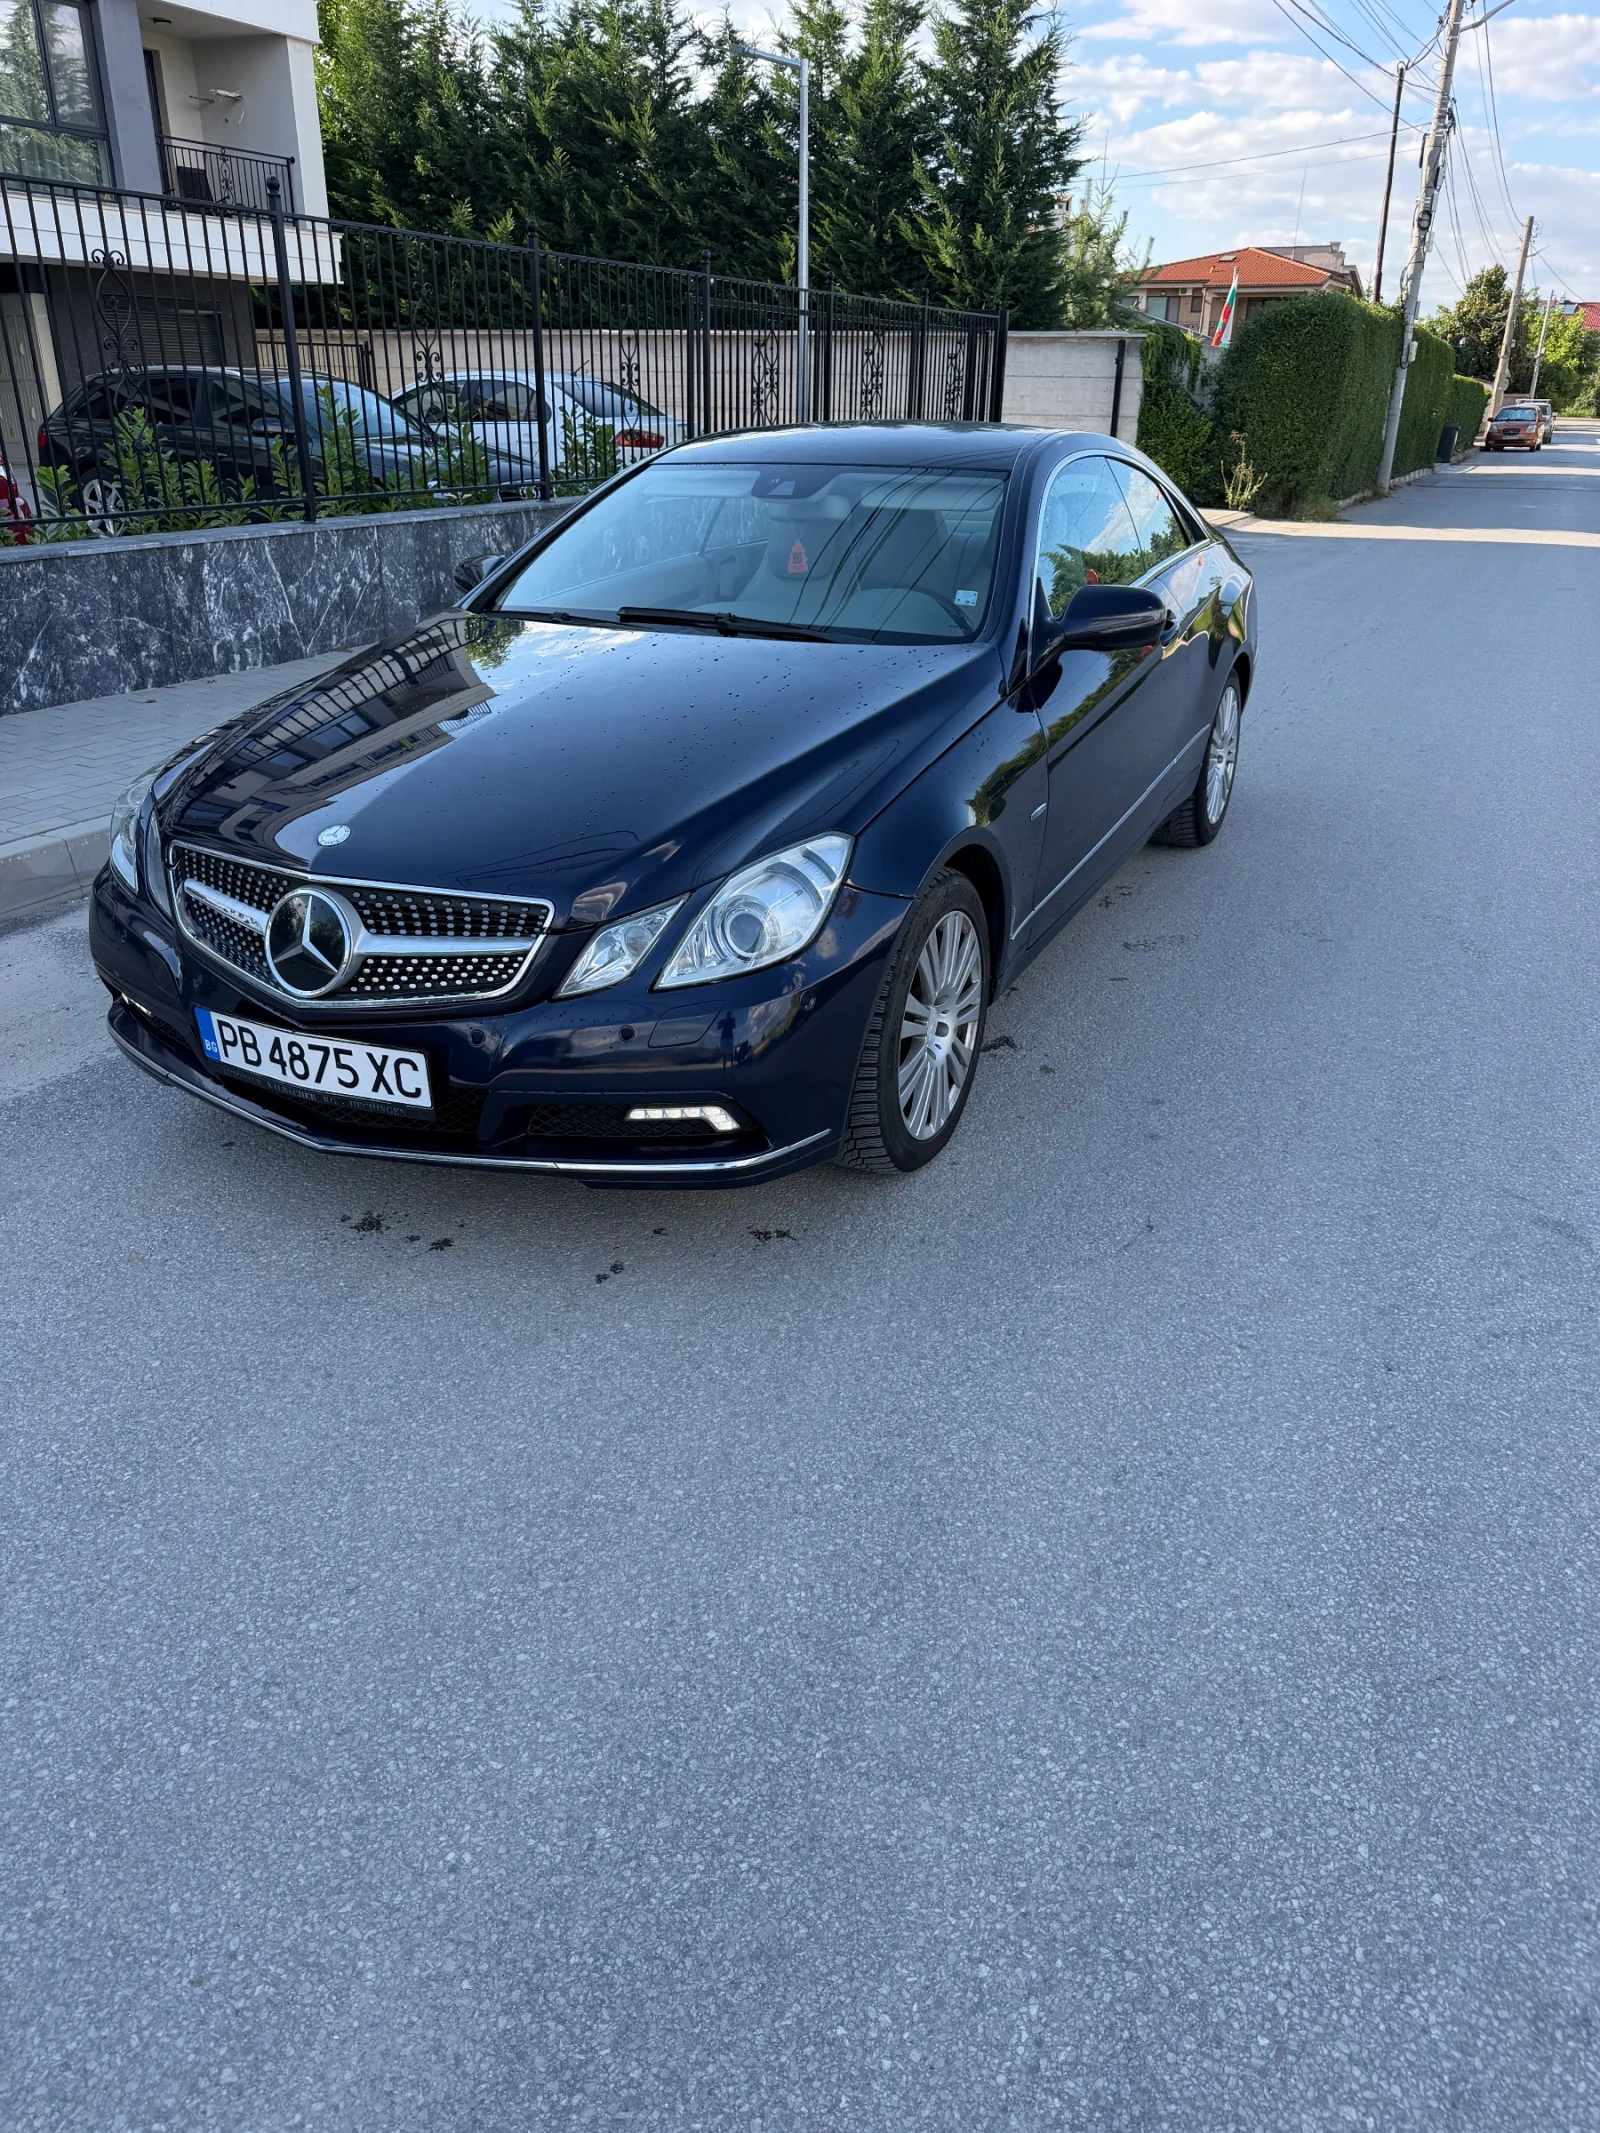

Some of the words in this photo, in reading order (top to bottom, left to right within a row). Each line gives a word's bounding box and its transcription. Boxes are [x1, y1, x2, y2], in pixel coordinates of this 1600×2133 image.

[205, 1039, 218, 1053] BG
[217, 1020, 262, 1067] PB
[269, 1036, 359, 1089] 4875
[366, 1051, 422, 1099] XC
[323, 1096, 337, 1105] KG
[349, 1101, 407, 1116] HECHINGEN
